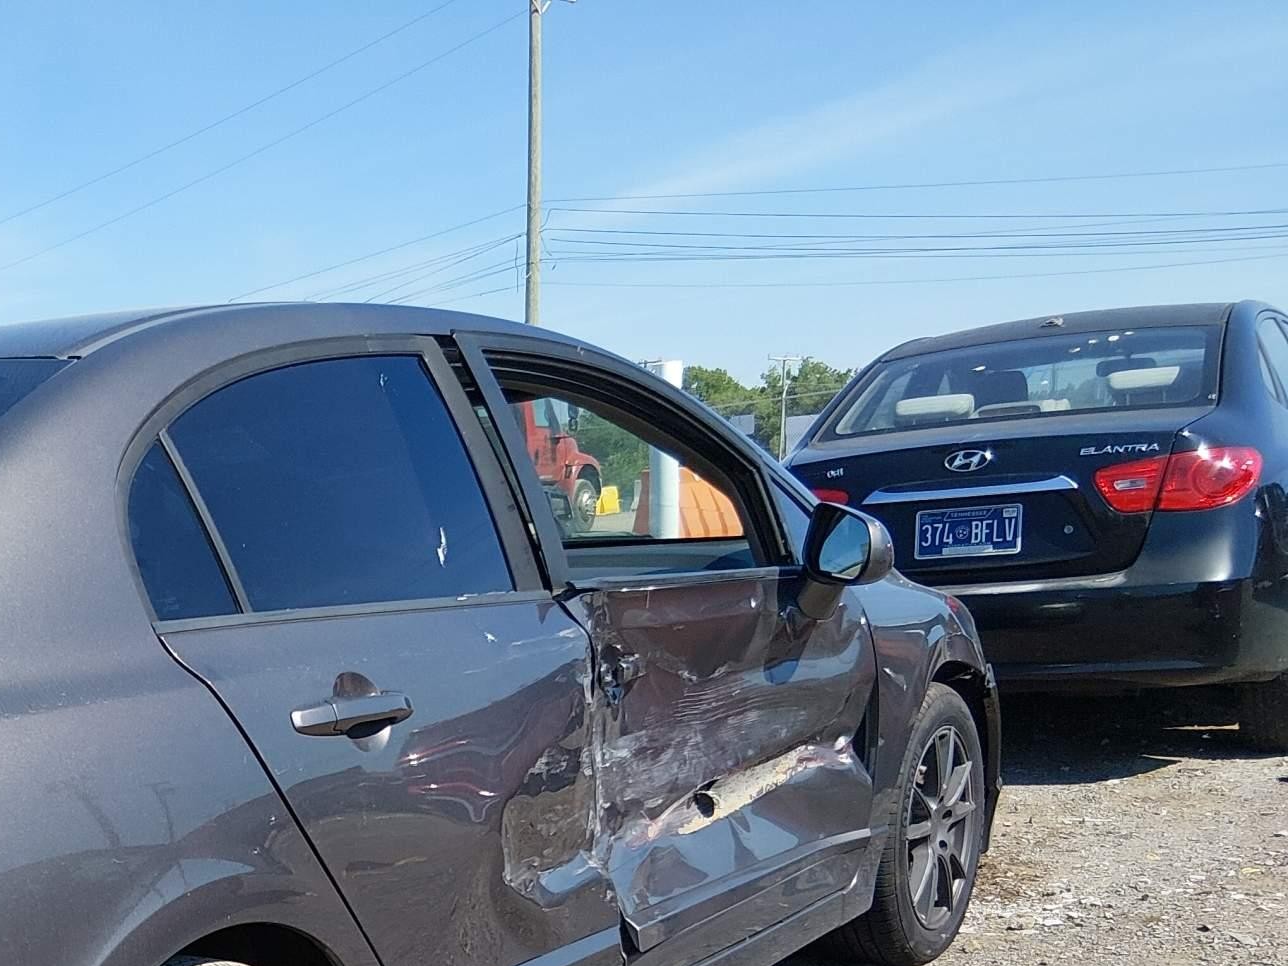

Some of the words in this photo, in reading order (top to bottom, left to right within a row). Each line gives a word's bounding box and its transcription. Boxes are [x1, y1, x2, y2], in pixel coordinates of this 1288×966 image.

[1079, 443, 1159, 456] ELANTRA
[921, 523, 953, 547] 374
[971, 518, 1016, 544] BFLV
